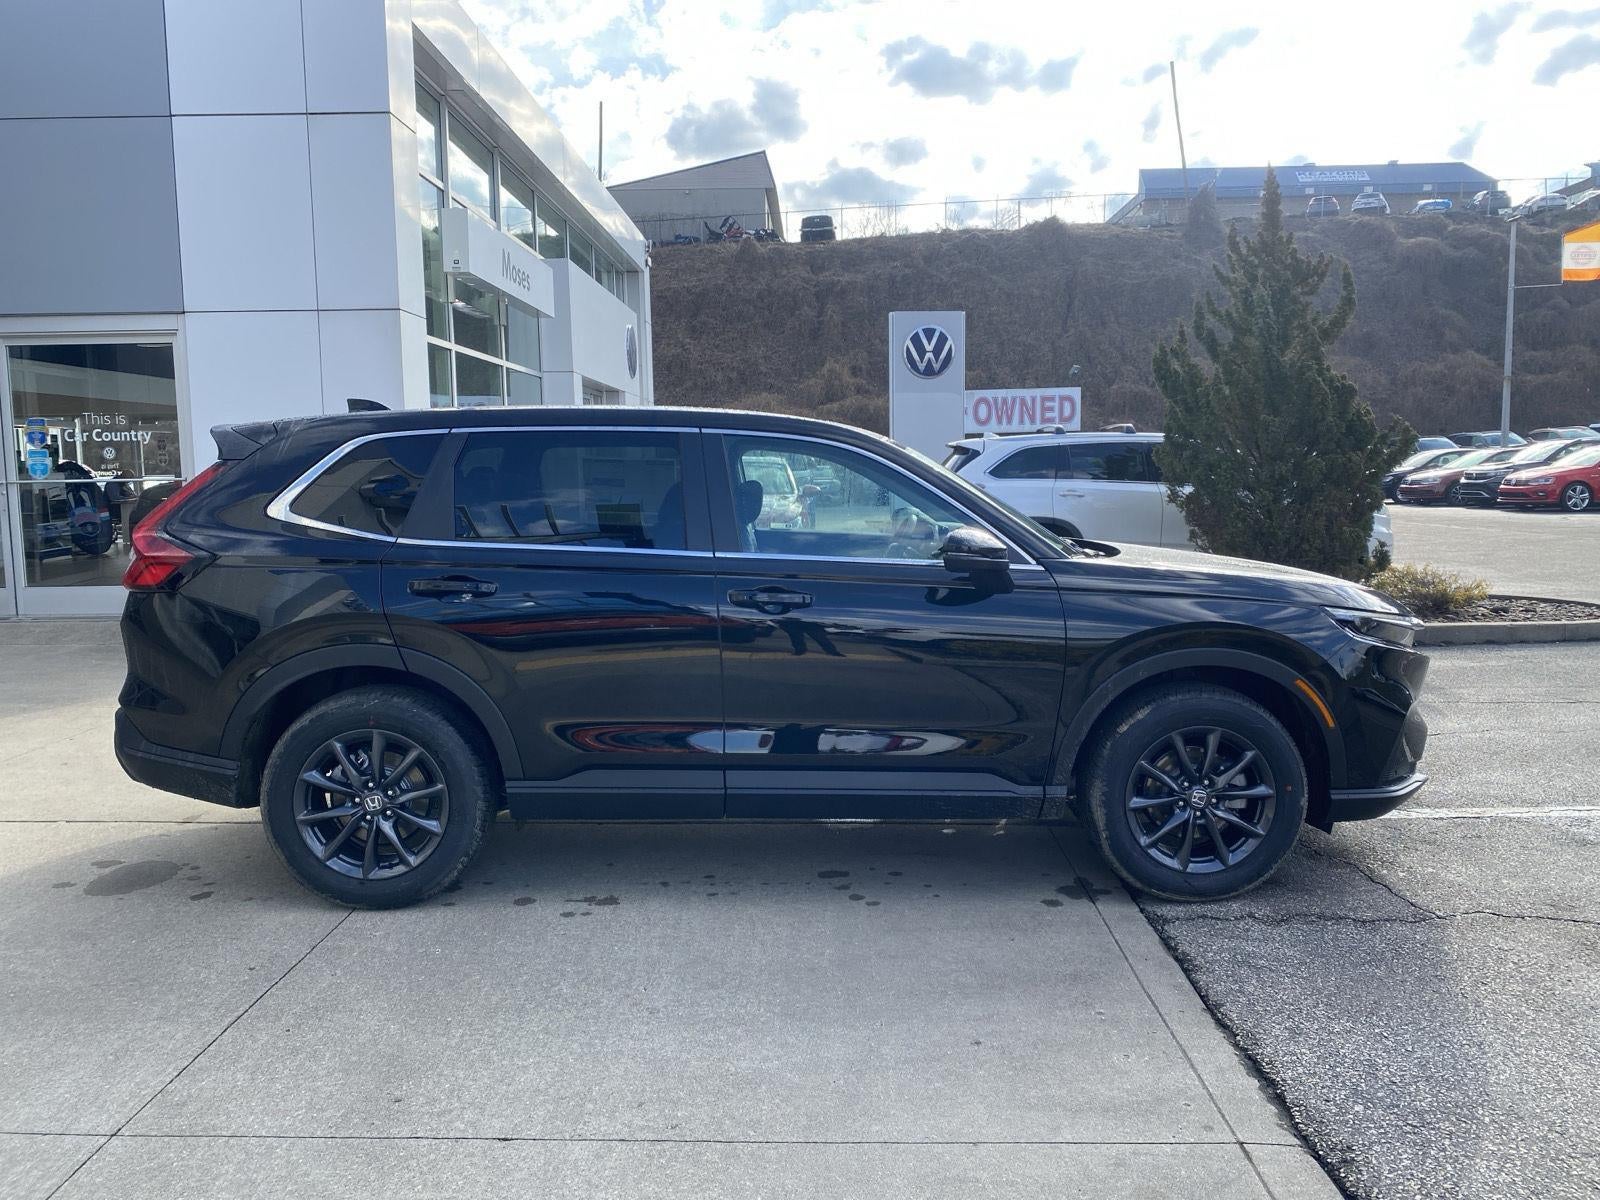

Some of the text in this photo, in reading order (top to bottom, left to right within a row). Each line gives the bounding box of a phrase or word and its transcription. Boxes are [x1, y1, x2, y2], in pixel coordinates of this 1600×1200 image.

[502, 248, 530, 291] Moses
[82, 412, 126, 425] This is
[972, 394, 1076, 427] OWNED
[64, 429, 89, 442] Car
[92, 428, 152, 444] Country
